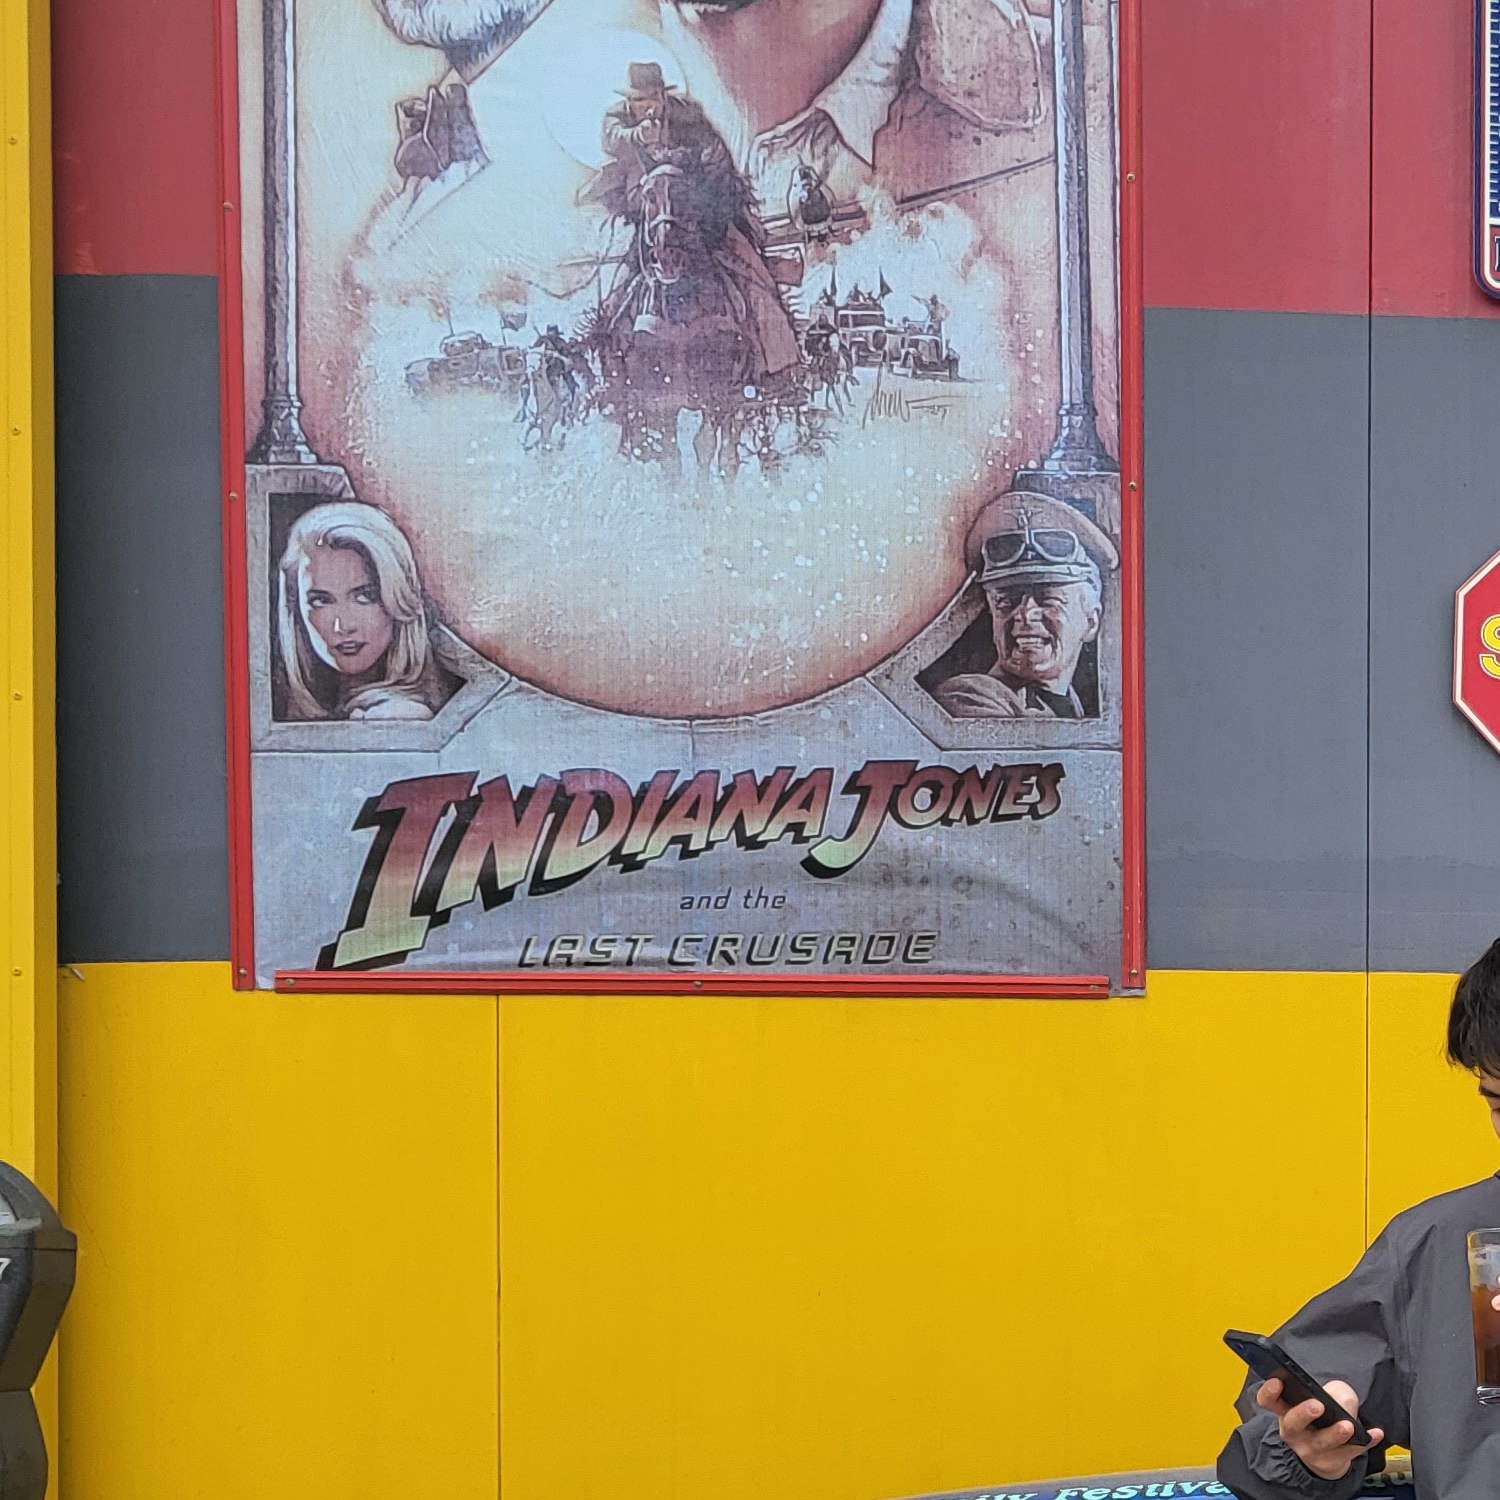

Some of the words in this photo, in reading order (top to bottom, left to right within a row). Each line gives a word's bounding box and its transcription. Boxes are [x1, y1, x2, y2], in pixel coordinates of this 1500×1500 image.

[316, 767, 825, 972] INDIANA
[802, 760, 1066, 878] JONES
[680, 886, 733, 910] and
[743, 886, 787, 910] the
[518, 933, 664, 968] LAST
[667, 930, 940, 967] CRUSADE
